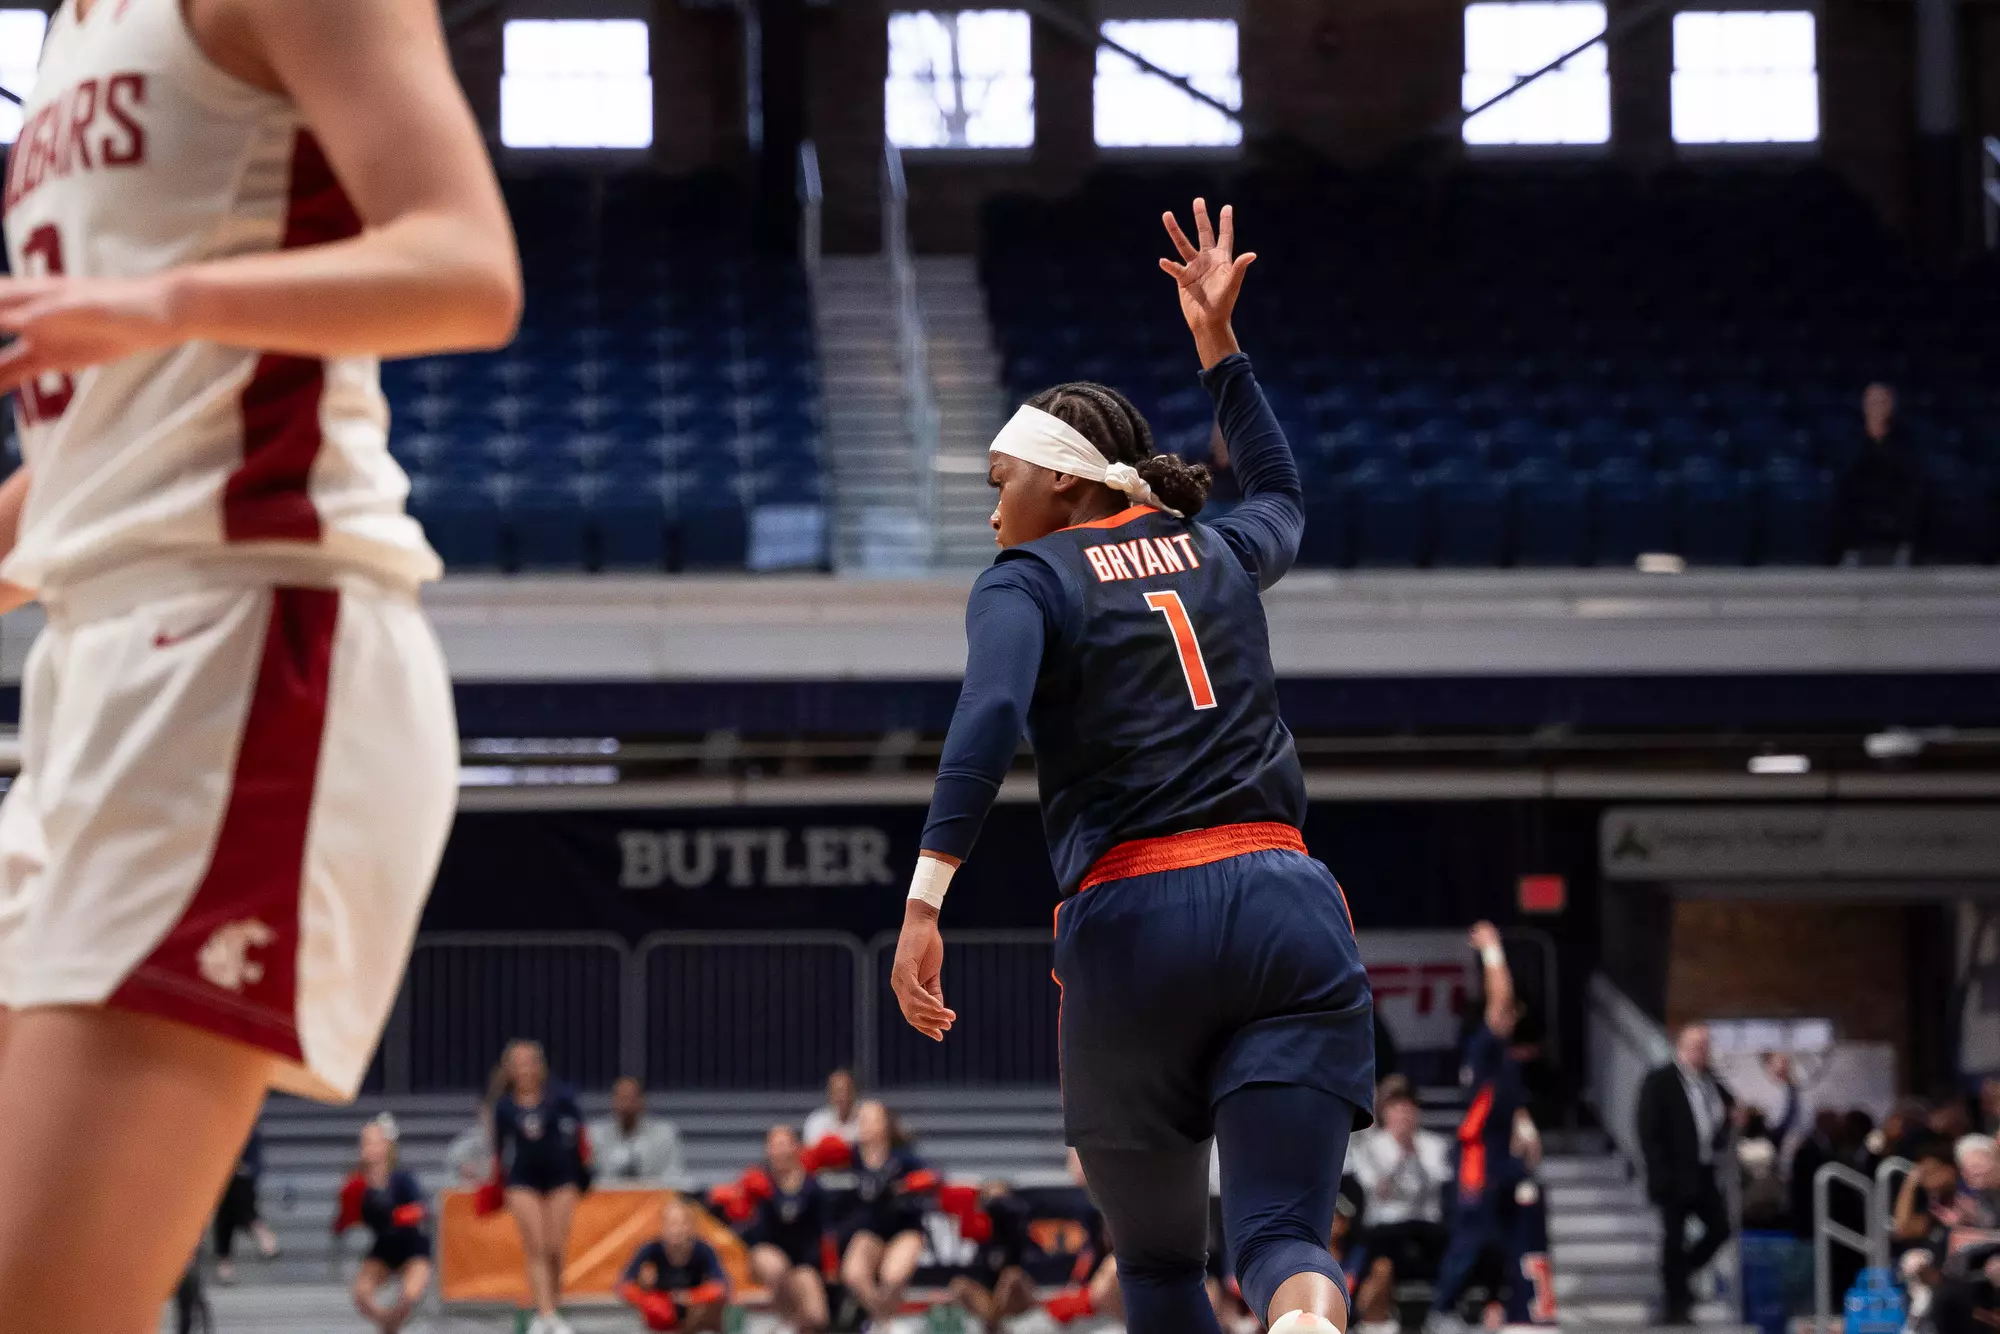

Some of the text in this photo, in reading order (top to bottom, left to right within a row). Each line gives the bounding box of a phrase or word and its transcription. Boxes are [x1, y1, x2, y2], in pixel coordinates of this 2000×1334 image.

[1083, 533, 1200, 583] BRYANT
[1142, 590, 1218, 711] 1
[617, 828, 893, 888] BUTLER
